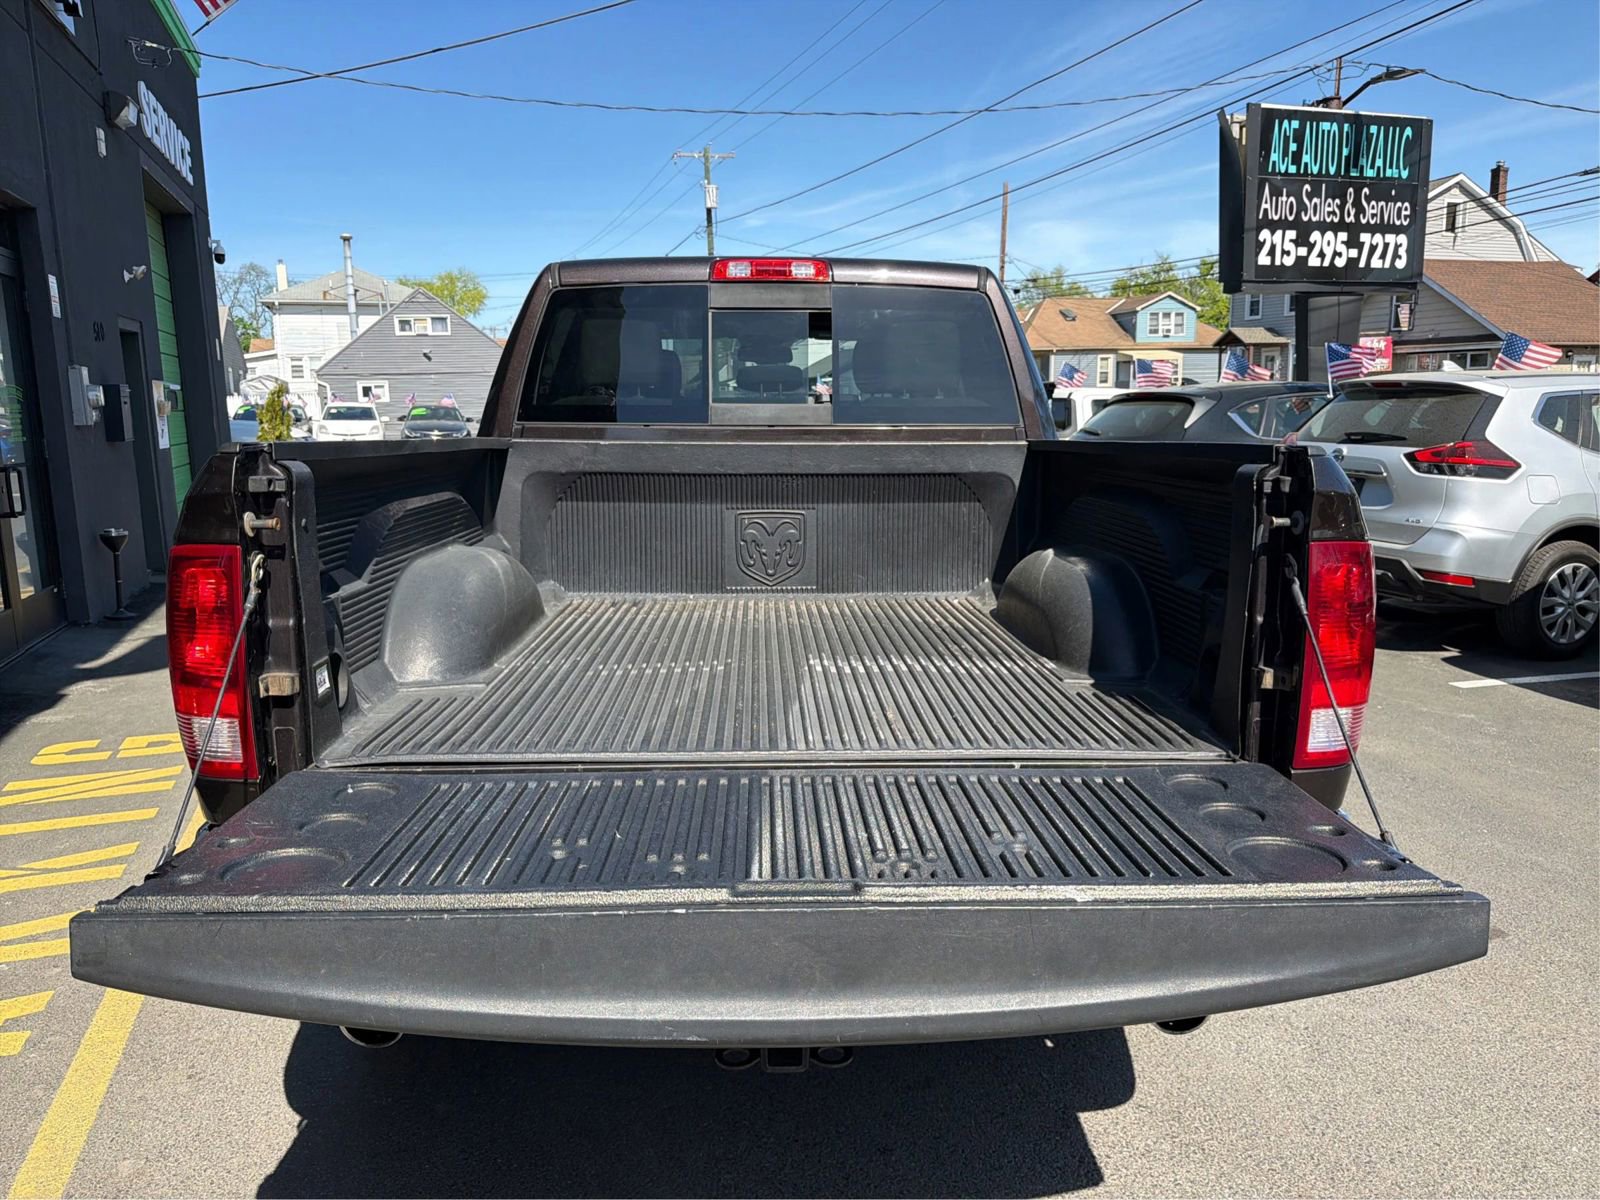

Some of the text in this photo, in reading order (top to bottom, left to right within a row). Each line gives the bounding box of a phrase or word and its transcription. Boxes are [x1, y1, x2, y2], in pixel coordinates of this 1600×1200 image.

[138, 81, 194, 186] SERVICE
[1268, 119, 1413, 179] ACE AUTO PLAZA LLC
[1258, 182, 1411, 226] Auto Sales & Service
[1257, 228, 1408, 269] 215-295-7273
